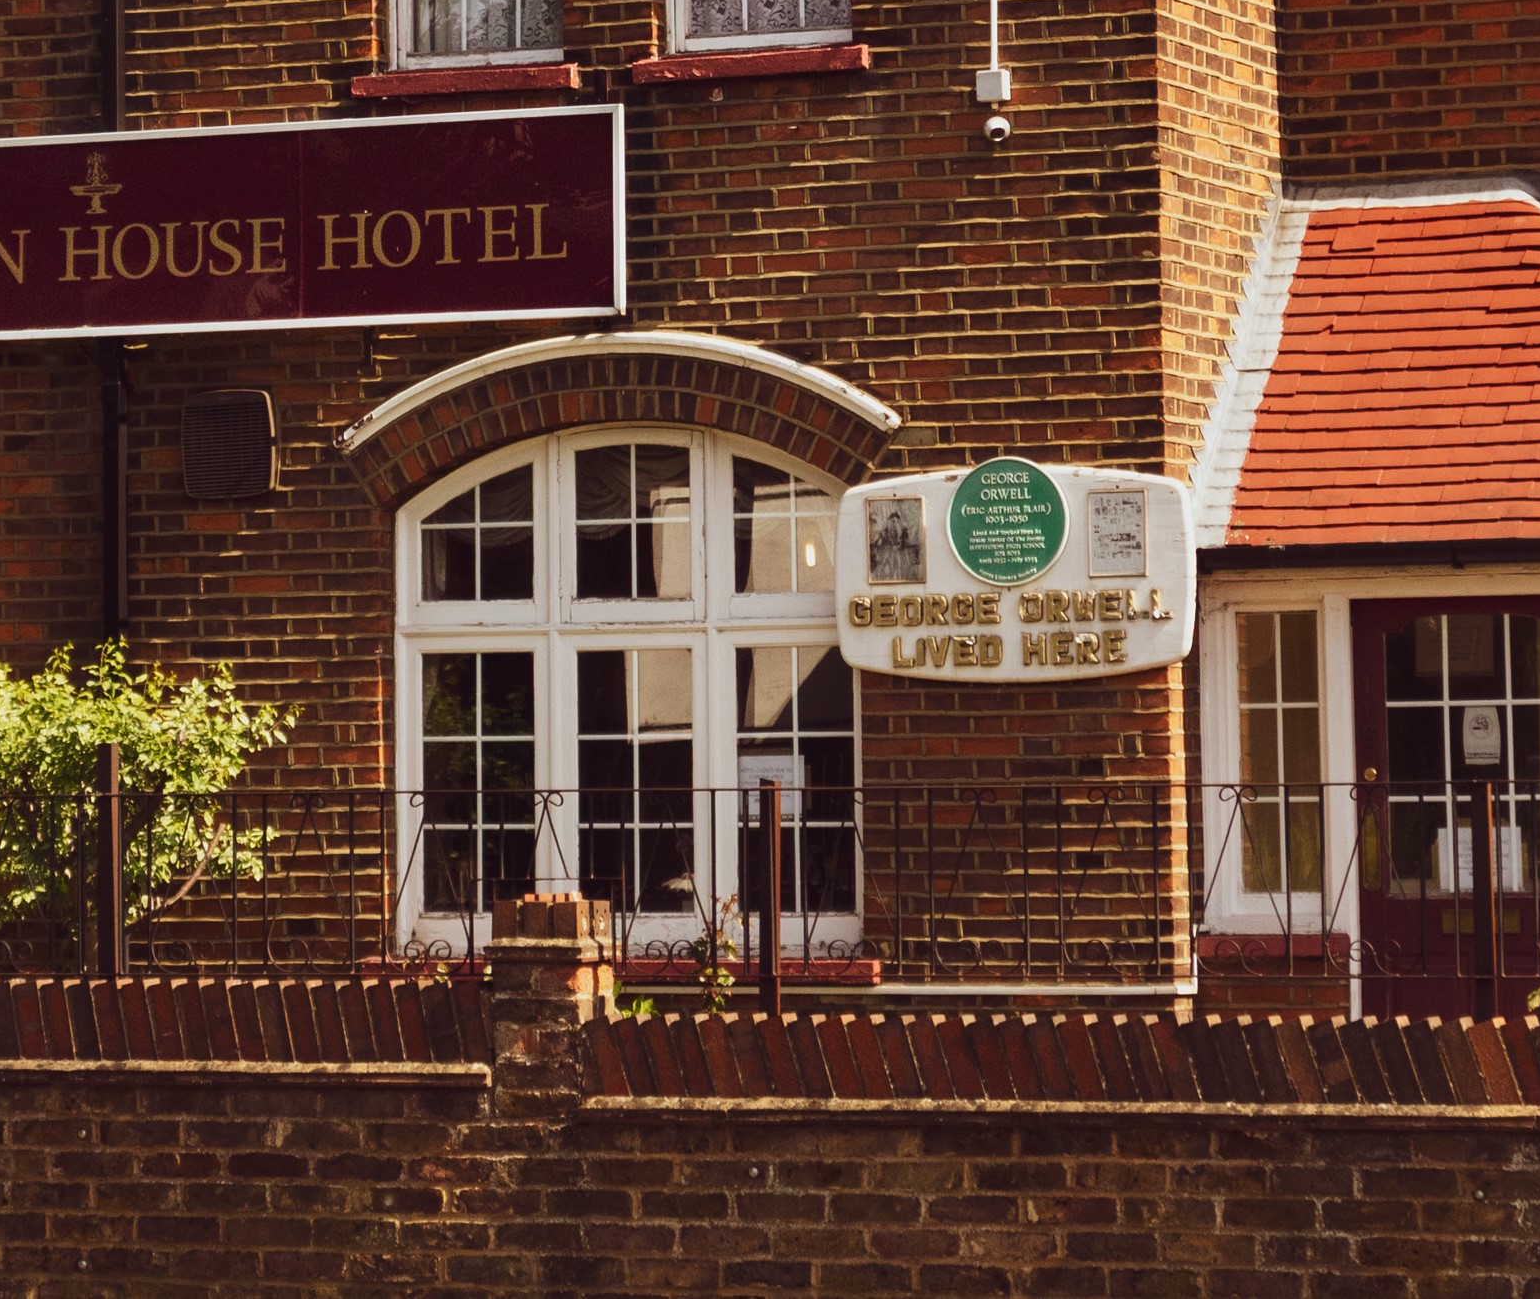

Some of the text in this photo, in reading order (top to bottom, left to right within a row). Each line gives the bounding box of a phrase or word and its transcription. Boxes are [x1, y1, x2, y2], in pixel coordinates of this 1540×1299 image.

[59, 216, 286, 282] HOUSE
[318, 203, 568, 271] HOTEL
[981, 472, 1030, 485] GEORGE
[981, 487, 1032, 500] ORWELL
[961, 502, 1051, 517] (ERIC ARTHUR BLAIR)
[985, 515, 1028, 524] 1903-1950
[849, 588, 1174, 627] GEORGE ORWELL
[891, 629, 1127, 669] LIVED HERE
